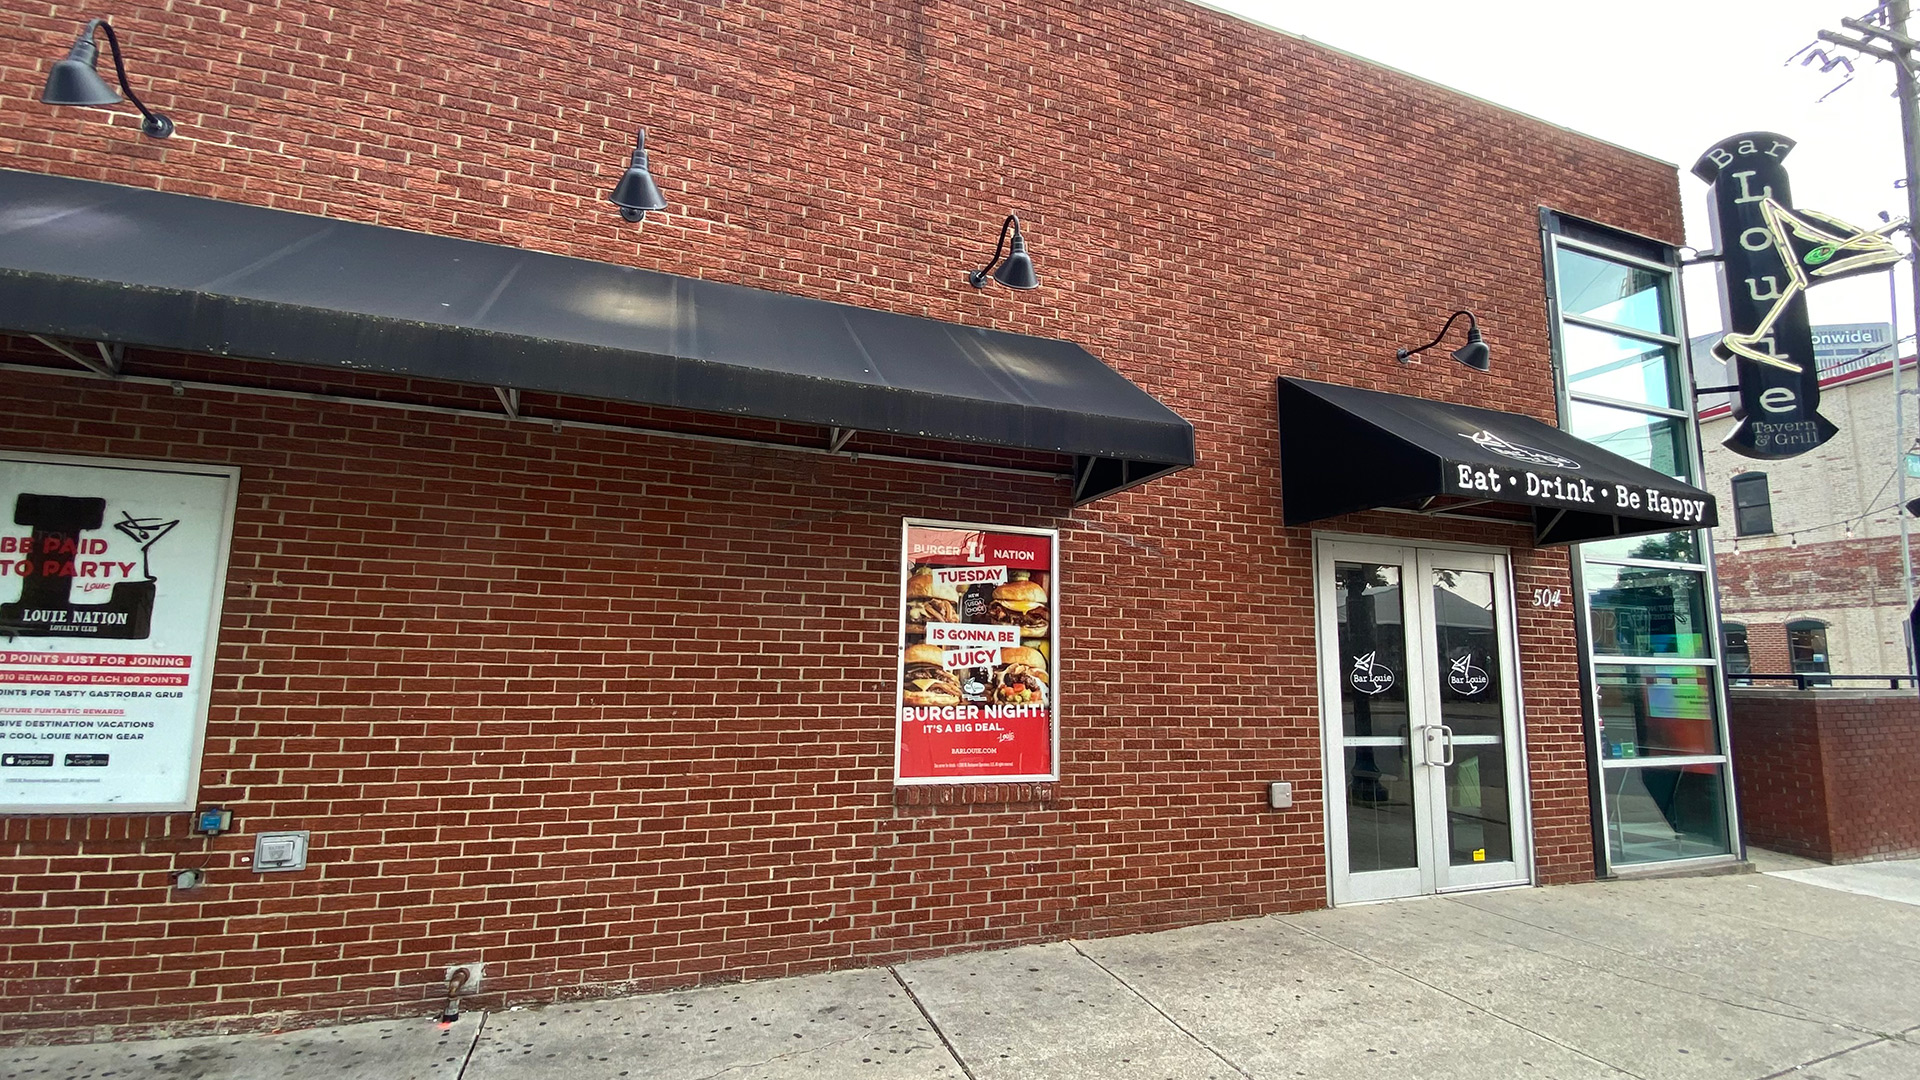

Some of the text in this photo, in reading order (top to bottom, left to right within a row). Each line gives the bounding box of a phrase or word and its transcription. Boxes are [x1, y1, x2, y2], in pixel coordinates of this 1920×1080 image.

[1706, 139, 1789, 170] Bar
[1732, 170, 1798, 413] Louie
[1751, 421, 1817, 433] Tavern
[1755, 431, 1818, 446] & Grill
[1457, 464, 1705, 521] Eat Drink Be Happy
[1, 537, 108, 554] BE PAID
[914, 544, 961, 555] BURGER
[993, 550, 1035, 560] NATION
[0, 560, 136, 577] TO PARTY
[938, 569, 1003, 583] TUESDAY
[1532, 588, 1561, 607] 504
[22, 609, 128, 625] LOUIE NATION
[49, 624, 80, 632] LOYALTY
[932, 629, 1014, 642] IS GONNA BE
[10, 654, 59, 663] POINTS
[62, 655, 96, 664] JUST
[100, 656, 126, 665] FOR
[129, 657, 184, 666] JOINING
[948, 650, 997, 667] JUICY
[18, 674, 63, 682] REWARD
[91, 675, 120, 683] EACH
[143, 676, 182, 684] POINTS
[1353, 674, 1392, 682] Bar Louie
[1451, 675, 1487, 684] Bar Louie
[30, 689, 51, 697] FOR
[89, 690, 152, 698] GASTROBAR
[903, 703, 1046, 722] BURGER NIGHT!
[923, 722, 1005, 734] IT'S A BIG DEAL.
